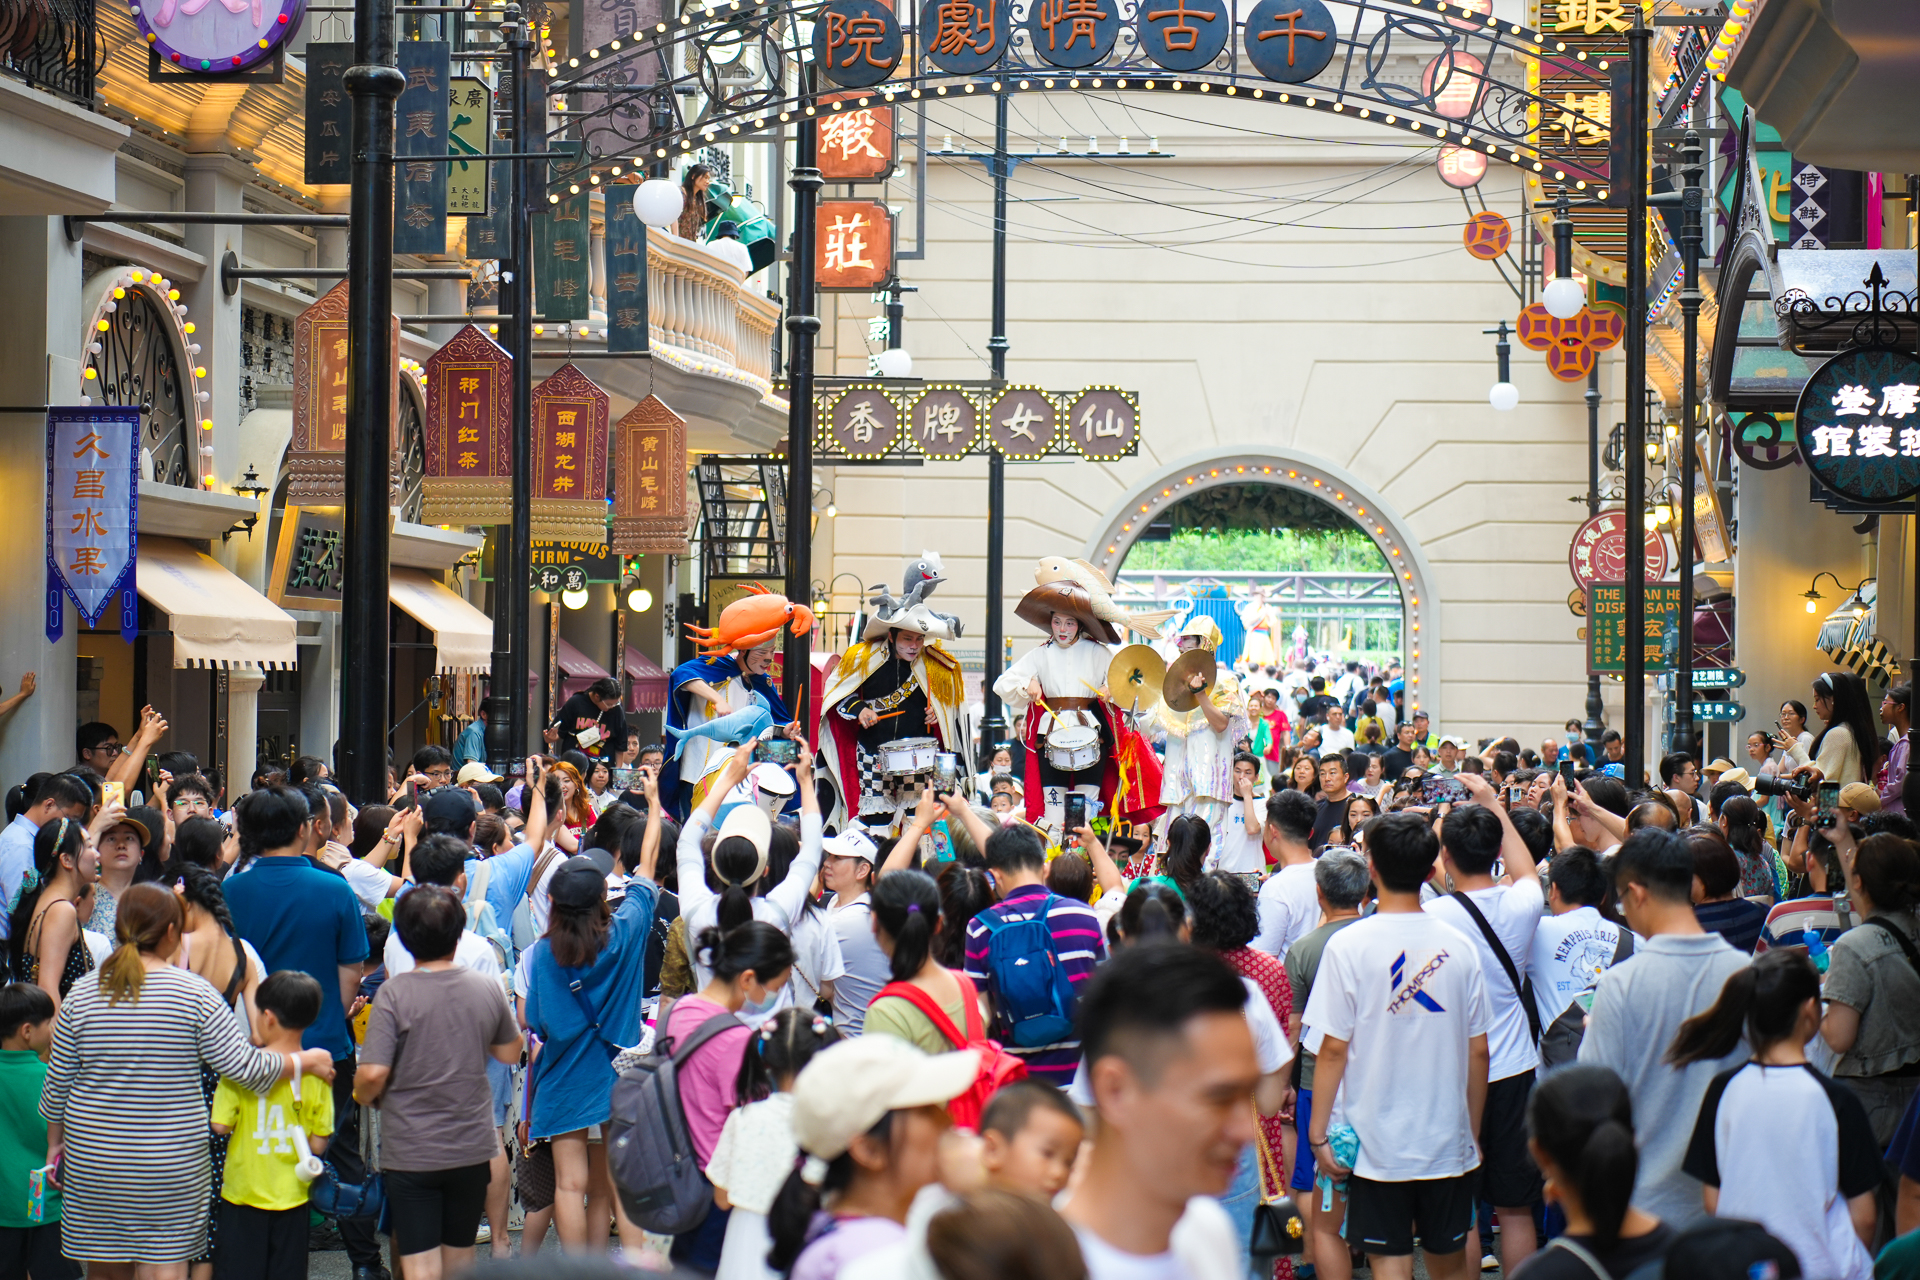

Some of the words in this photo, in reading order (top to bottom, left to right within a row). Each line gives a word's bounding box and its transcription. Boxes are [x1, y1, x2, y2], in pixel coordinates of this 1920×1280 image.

[319, 60, 342, 167] 六安瓜片
[403, 66, 438, 229] 武夷岩茶
[457, 377, 480, 470] 祁门红茶
[552, 410, 578, 492] 西湖龙井
[69, 431, 111, 576] 久昌水果
[640, 436, 659, 512] 黄山毛峰
[532, 551, 569, 564] FIRM
[1595, 589, 1620, 600] THE
[1644, 589, 1661, 600] AN
[1692, 703, 1724, 715] 洗手间
[1386, 948, 1450, 1015] THOMPSON
[1554, 929, 1592, 963] MEMPHIS
